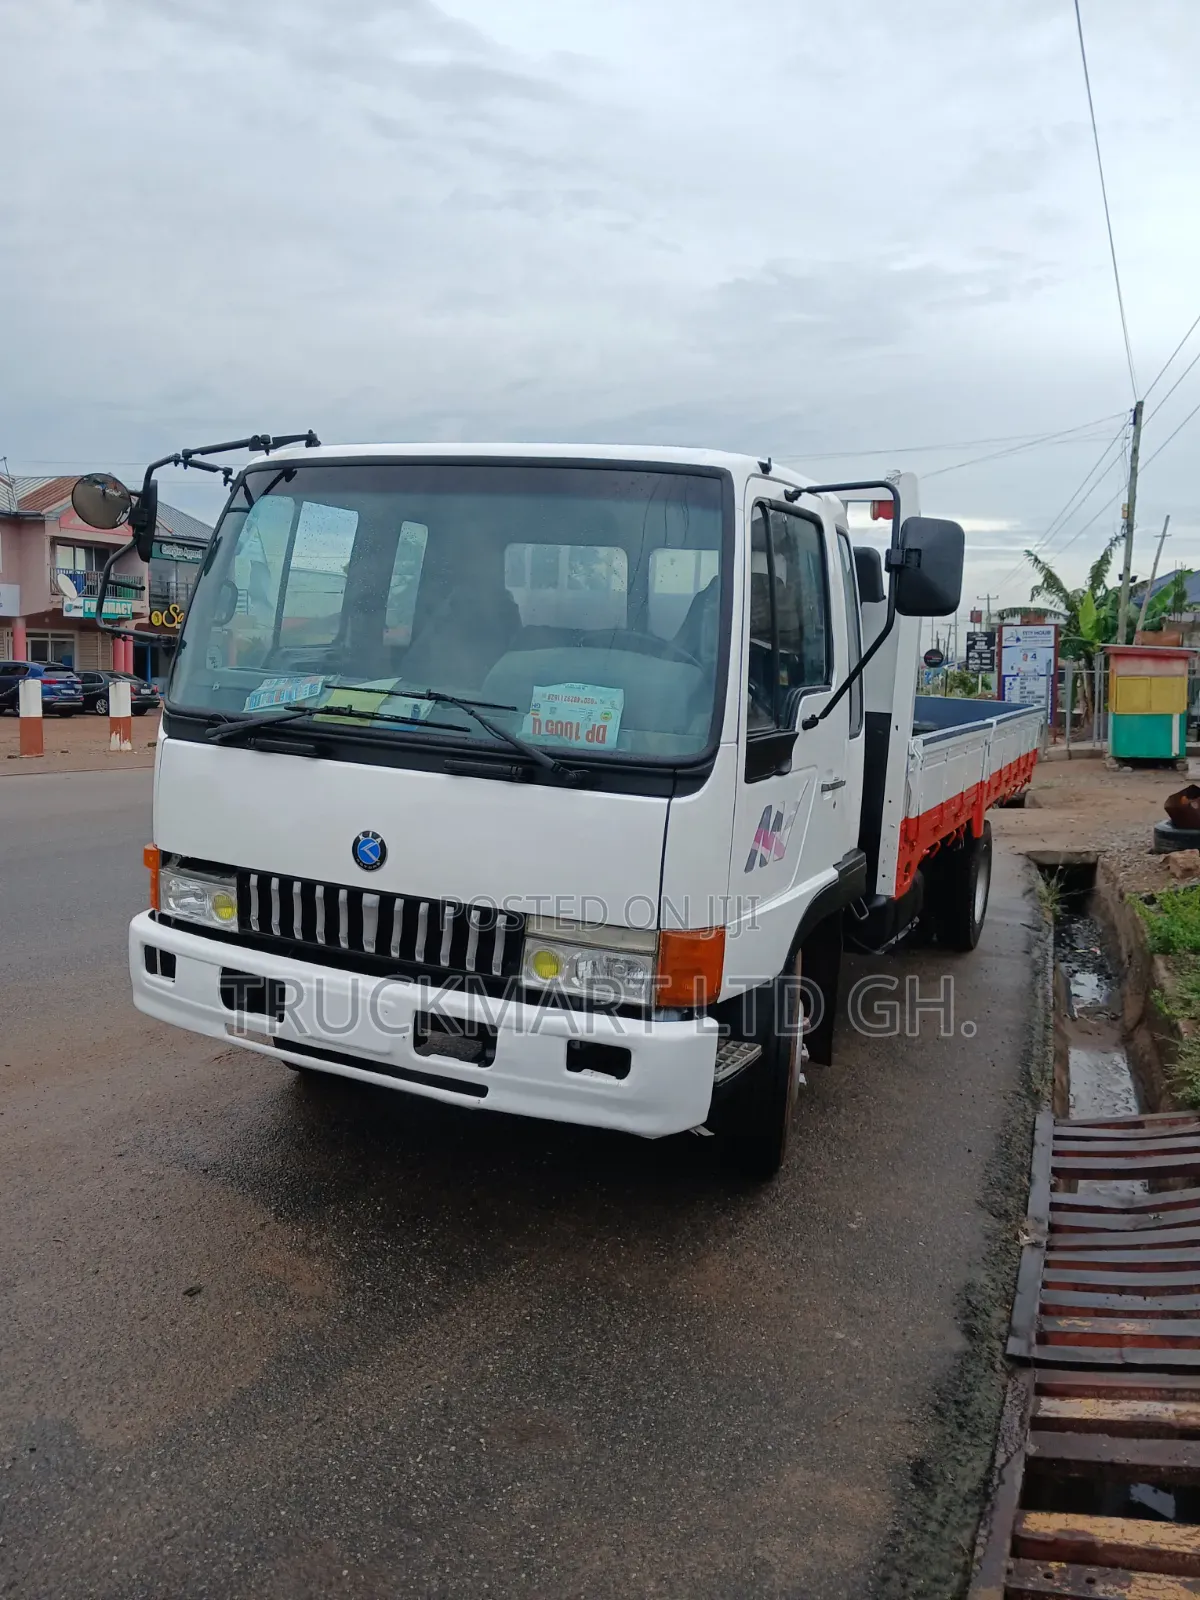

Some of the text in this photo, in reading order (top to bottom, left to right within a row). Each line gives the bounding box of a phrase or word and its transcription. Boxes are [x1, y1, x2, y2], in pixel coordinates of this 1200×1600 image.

[85, 600, 132, 615] PHRMACY
[586, 724, 607, 744] DP
[359, 832, 381, 843] KIA
